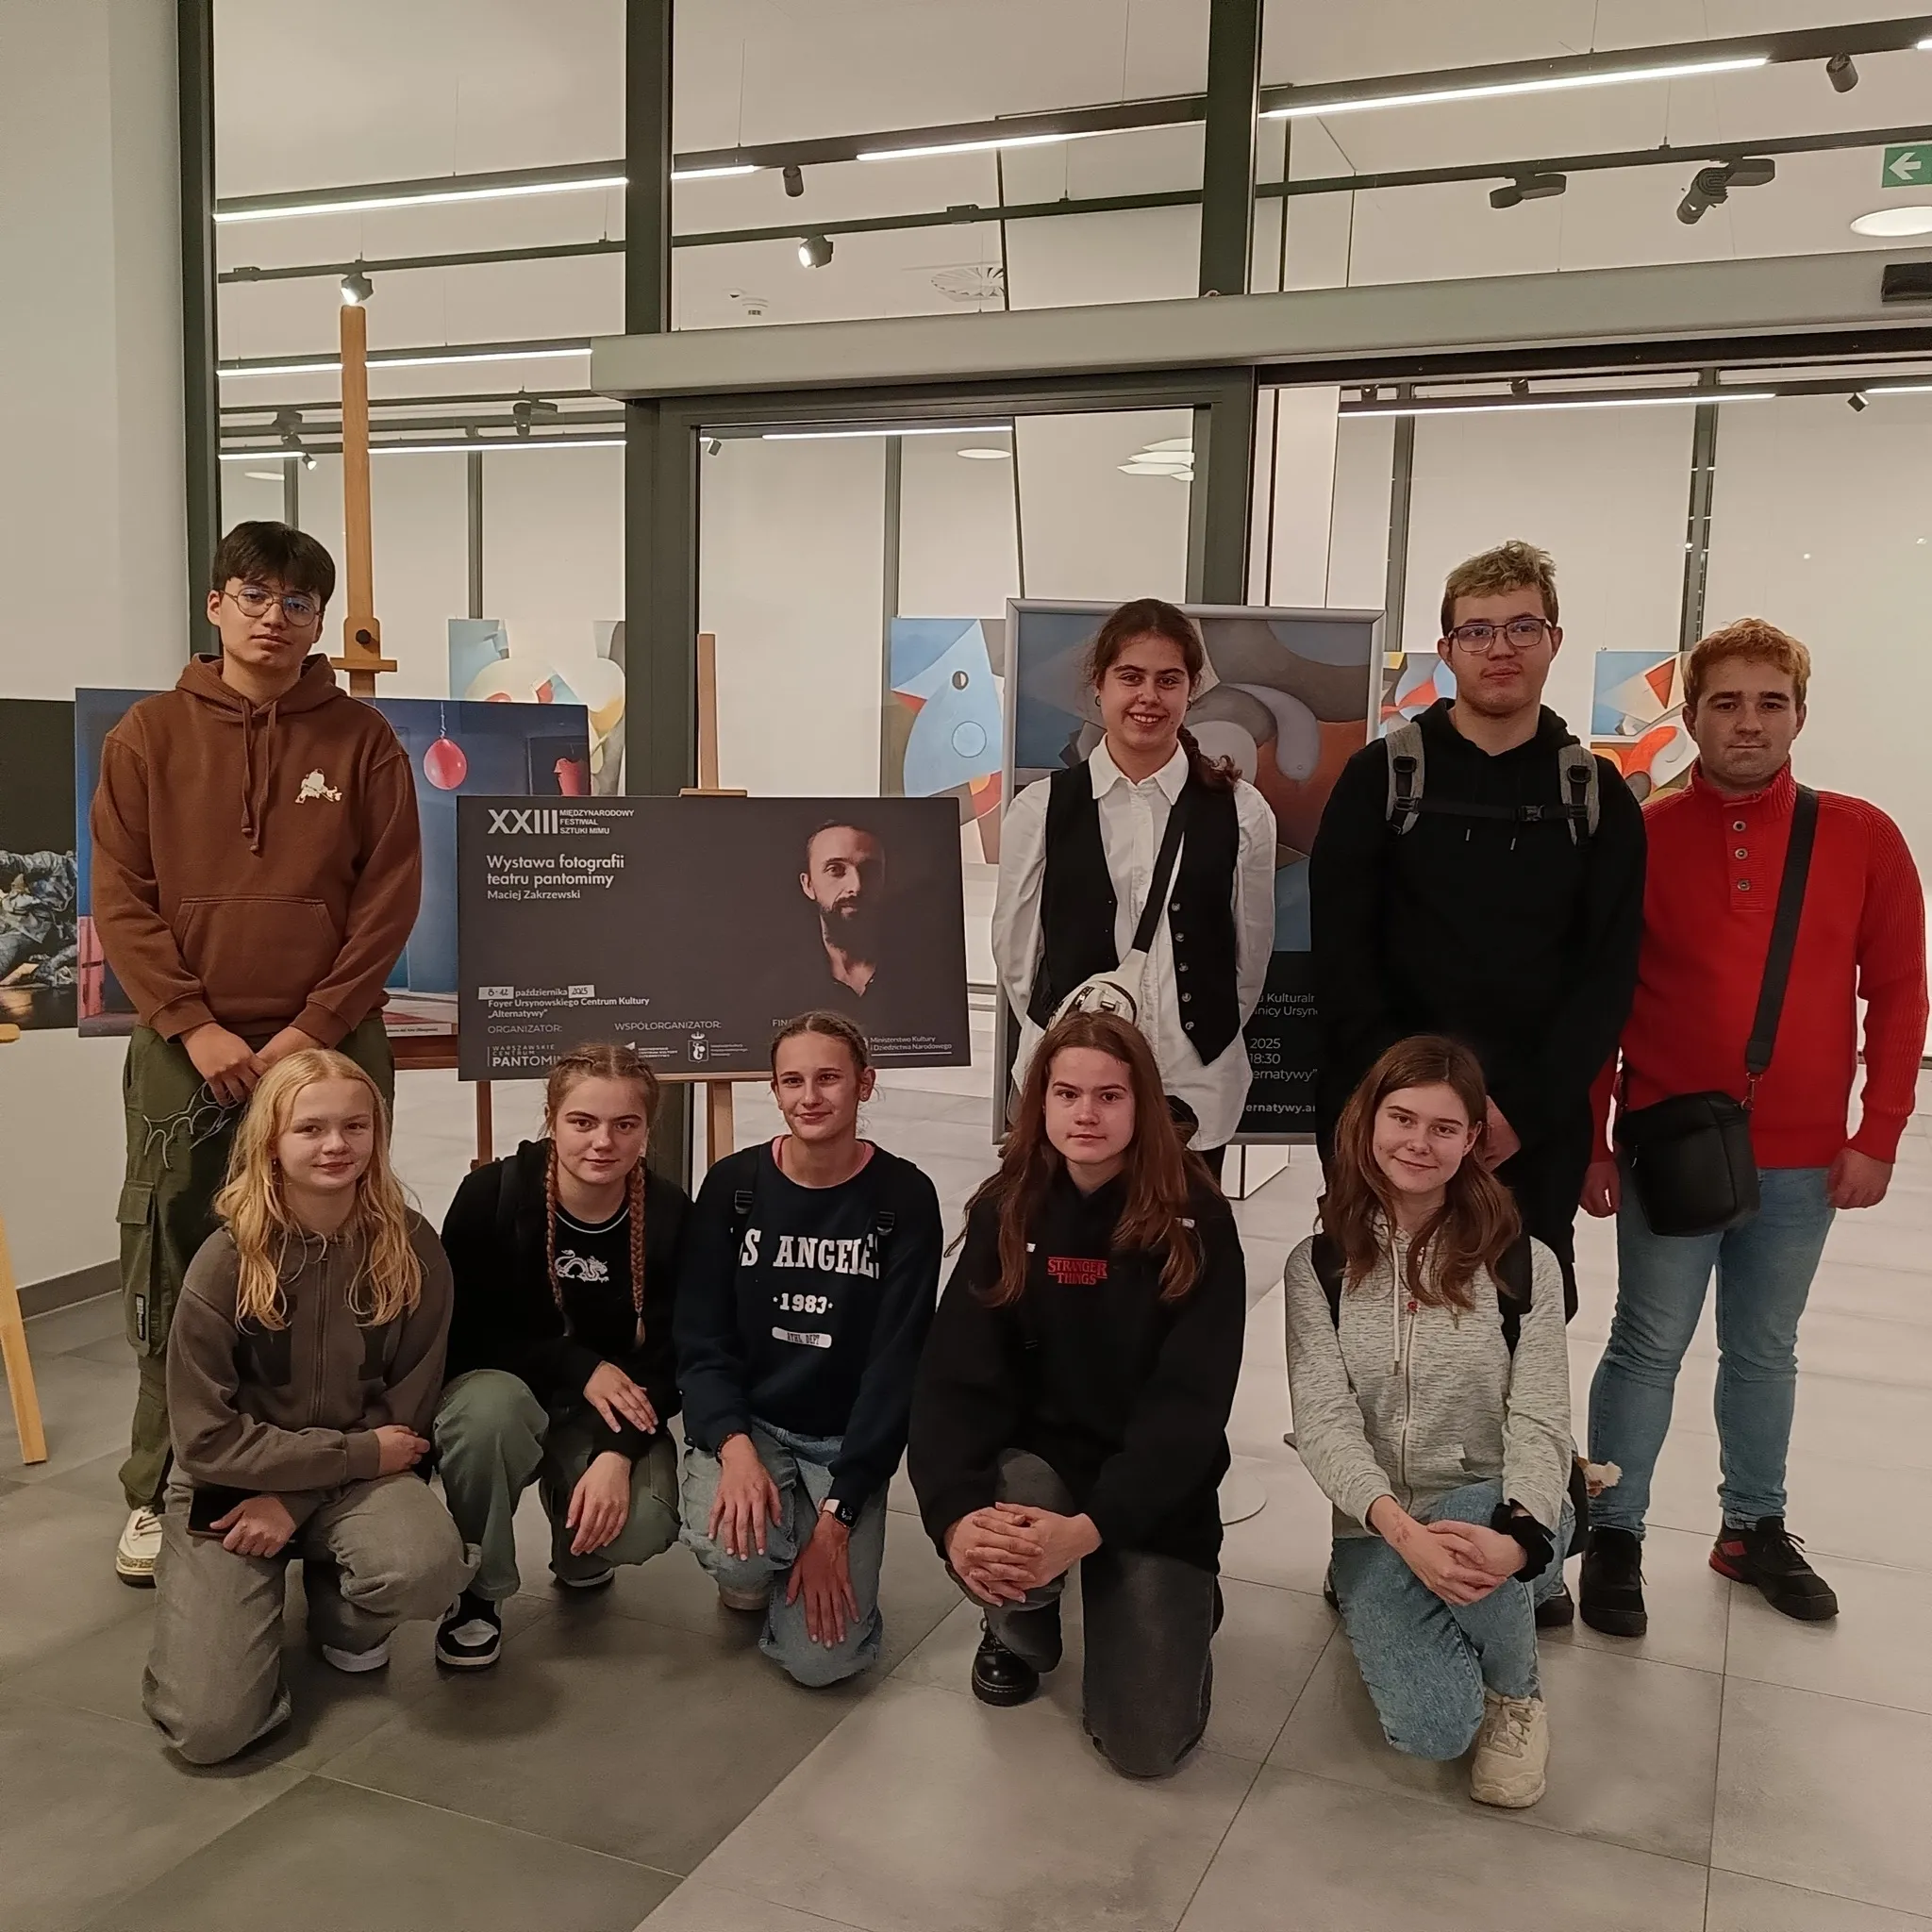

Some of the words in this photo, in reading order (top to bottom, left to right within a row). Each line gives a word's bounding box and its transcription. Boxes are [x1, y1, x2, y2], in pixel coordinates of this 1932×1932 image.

[559, 808, 635, 817] MIĘDZYNARODOWY
[487, 808, 558, 835] XXIII
[589, 826, 610, 835] MIMU
[487, 855, 556, 872] Wystawa
[559, 854, 625, 873] fotografii
[487, 873, 529, 885] teatru
[534, 872, 614, 889] pantomimy
[487, 890, 522, 901] Maciej
[523, 889, 581, 899] Zakrzewski
[515, 988, 568, 998] października
[488, 999, 513, 1008] Foyer
[514, 998, 579, 1008] Ursynowskiego
[618, 996, 650, 1006] Kultury
[1255, 1005, 1281, 1018] nicy
[1283, 1006, 1319, 1018] Ursyn
[488, 1024, 563, 1034] ORGANIZATOR:
[614, 1020, 723, 1031] WSPÓŁORGANIZATOR:
[911, 1035, 937, 1043] Kultury
[1250, 1038, 1281, 1049] 2025
[1249, 1053, 1281, 1064] 18:30
[1252, 1068, 1318, 1082] ernatywy”
[1245, 1103, 1316, 1115] ernatywy.a
[1047, 1257, 1108, 1277] STRANGER
[1057, 1272, 1097, 1286] THINGS
[779, 1292, 828, 1314] 1983
